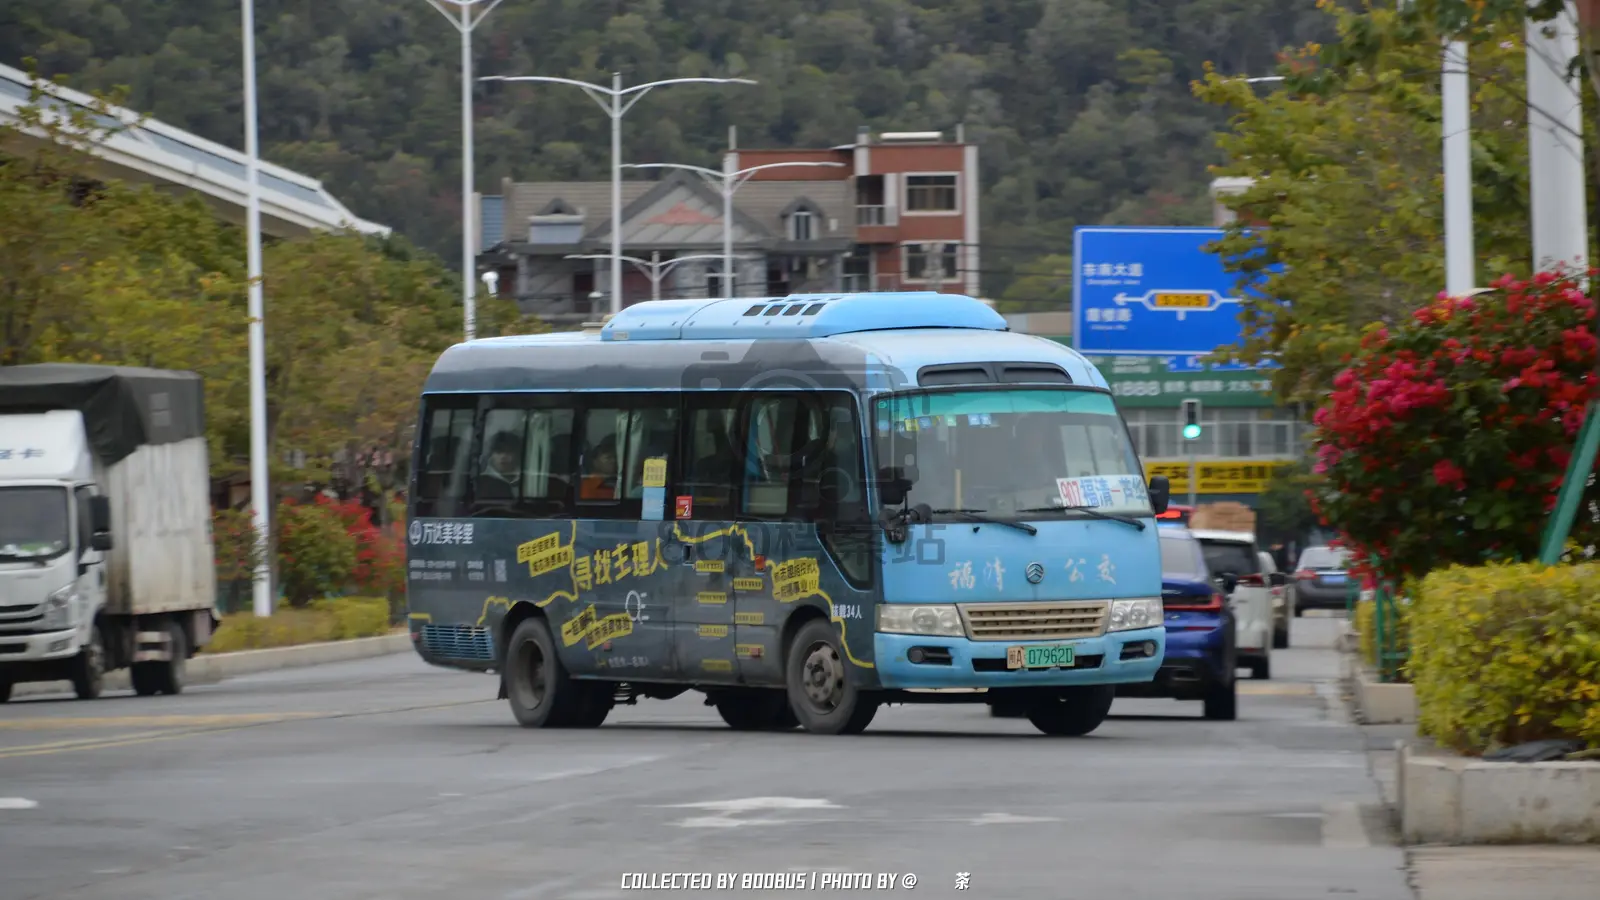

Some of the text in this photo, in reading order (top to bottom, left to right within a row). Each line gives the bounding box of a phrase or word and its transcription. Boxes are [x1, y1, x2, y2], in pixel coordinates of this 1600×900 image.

[422, 522, 474, 545] 万达美华里
[575, 537, 668, 591] 寻找主理人
[948, 553, 1117, 592] 福清 公交
